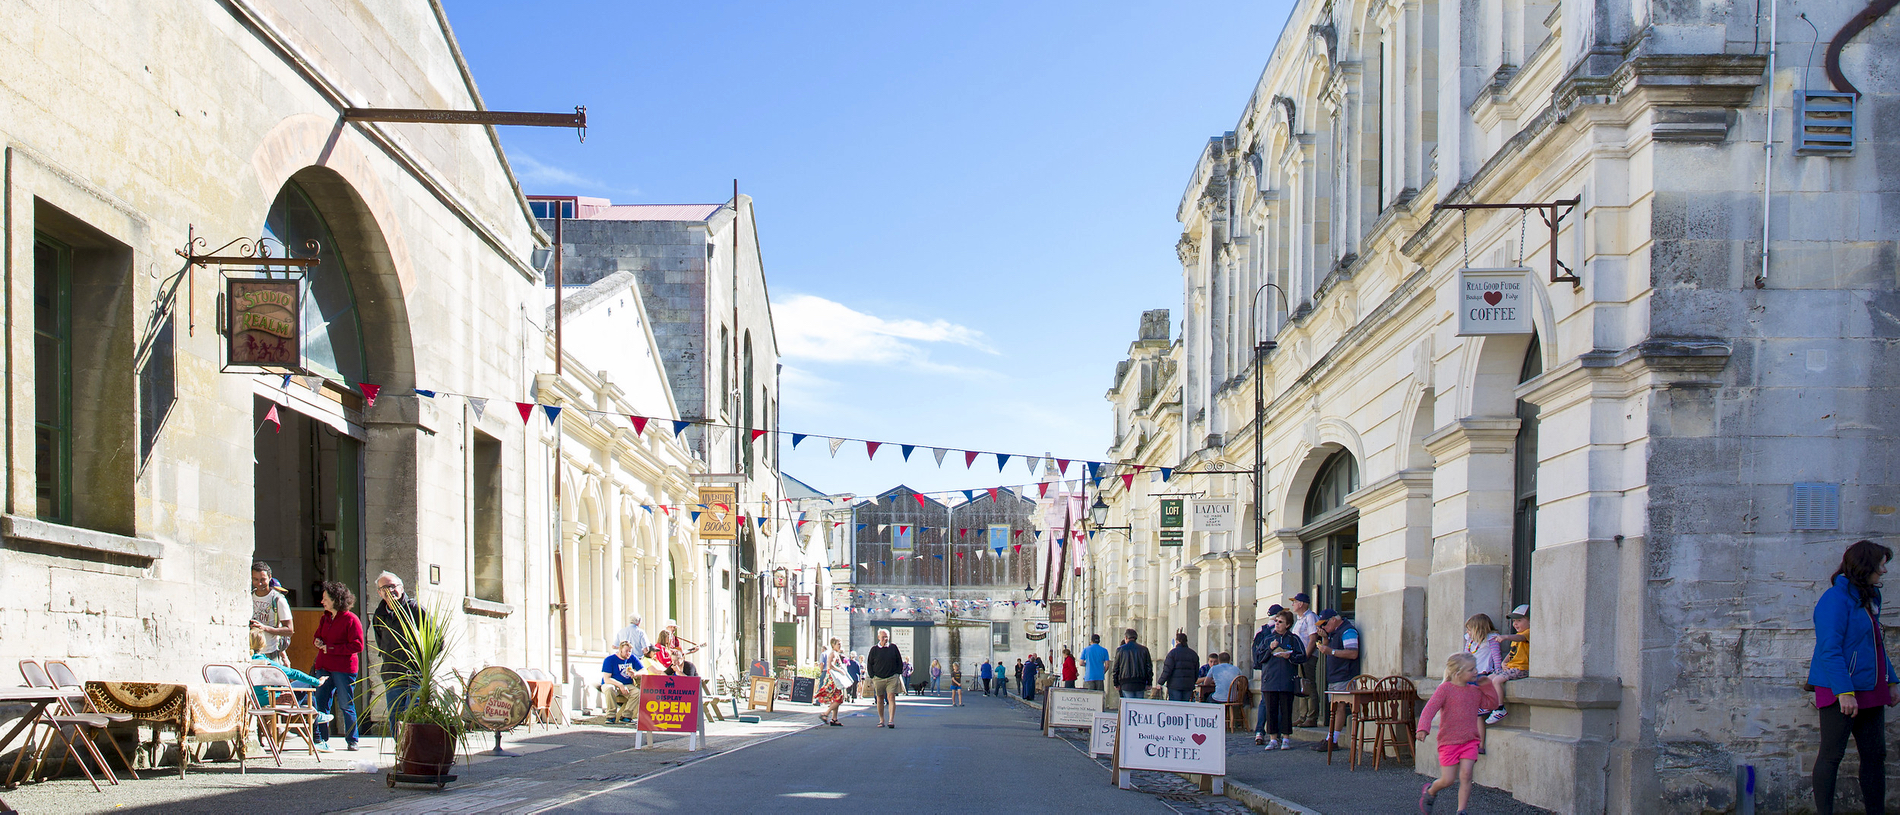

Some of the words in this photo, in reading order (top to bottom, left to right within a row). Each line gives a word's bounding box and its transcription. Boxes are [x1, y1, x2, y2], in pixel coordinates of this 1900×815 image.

[1466, 281, 1483, 291] REAL
[1483, 281, 1500, 290] GOOD
[1500, 281, 1520, 290] FUDGE
[244, 291, 290, 308] STUDIO
[1470, 307, 1516, 320] COFFEE
[242, 312, 289, 335] REALM
[702, 493, 733, 510] ADVENTURE
[1165, 506, 1180, 515] LOFT
[1195, 504, 1232, 513] LAZYCAT
[704, 521, 731, 531] BOOKS
[488, 697, 512, 710] STUDIO
[646, 700, 692, 713] OPEN
[485, 705, 509, 717] REALM
[650, 713, 686, 722] TODAY
[1128, 709, 1155, 727] REAL
[1157, 711, 1184, 729] GOOD
[1138, 732, 1165, 742] Boutique
[1168, 734, 1186, 744] Fudge
[1144, 743, 1201, 761] COFFEE
